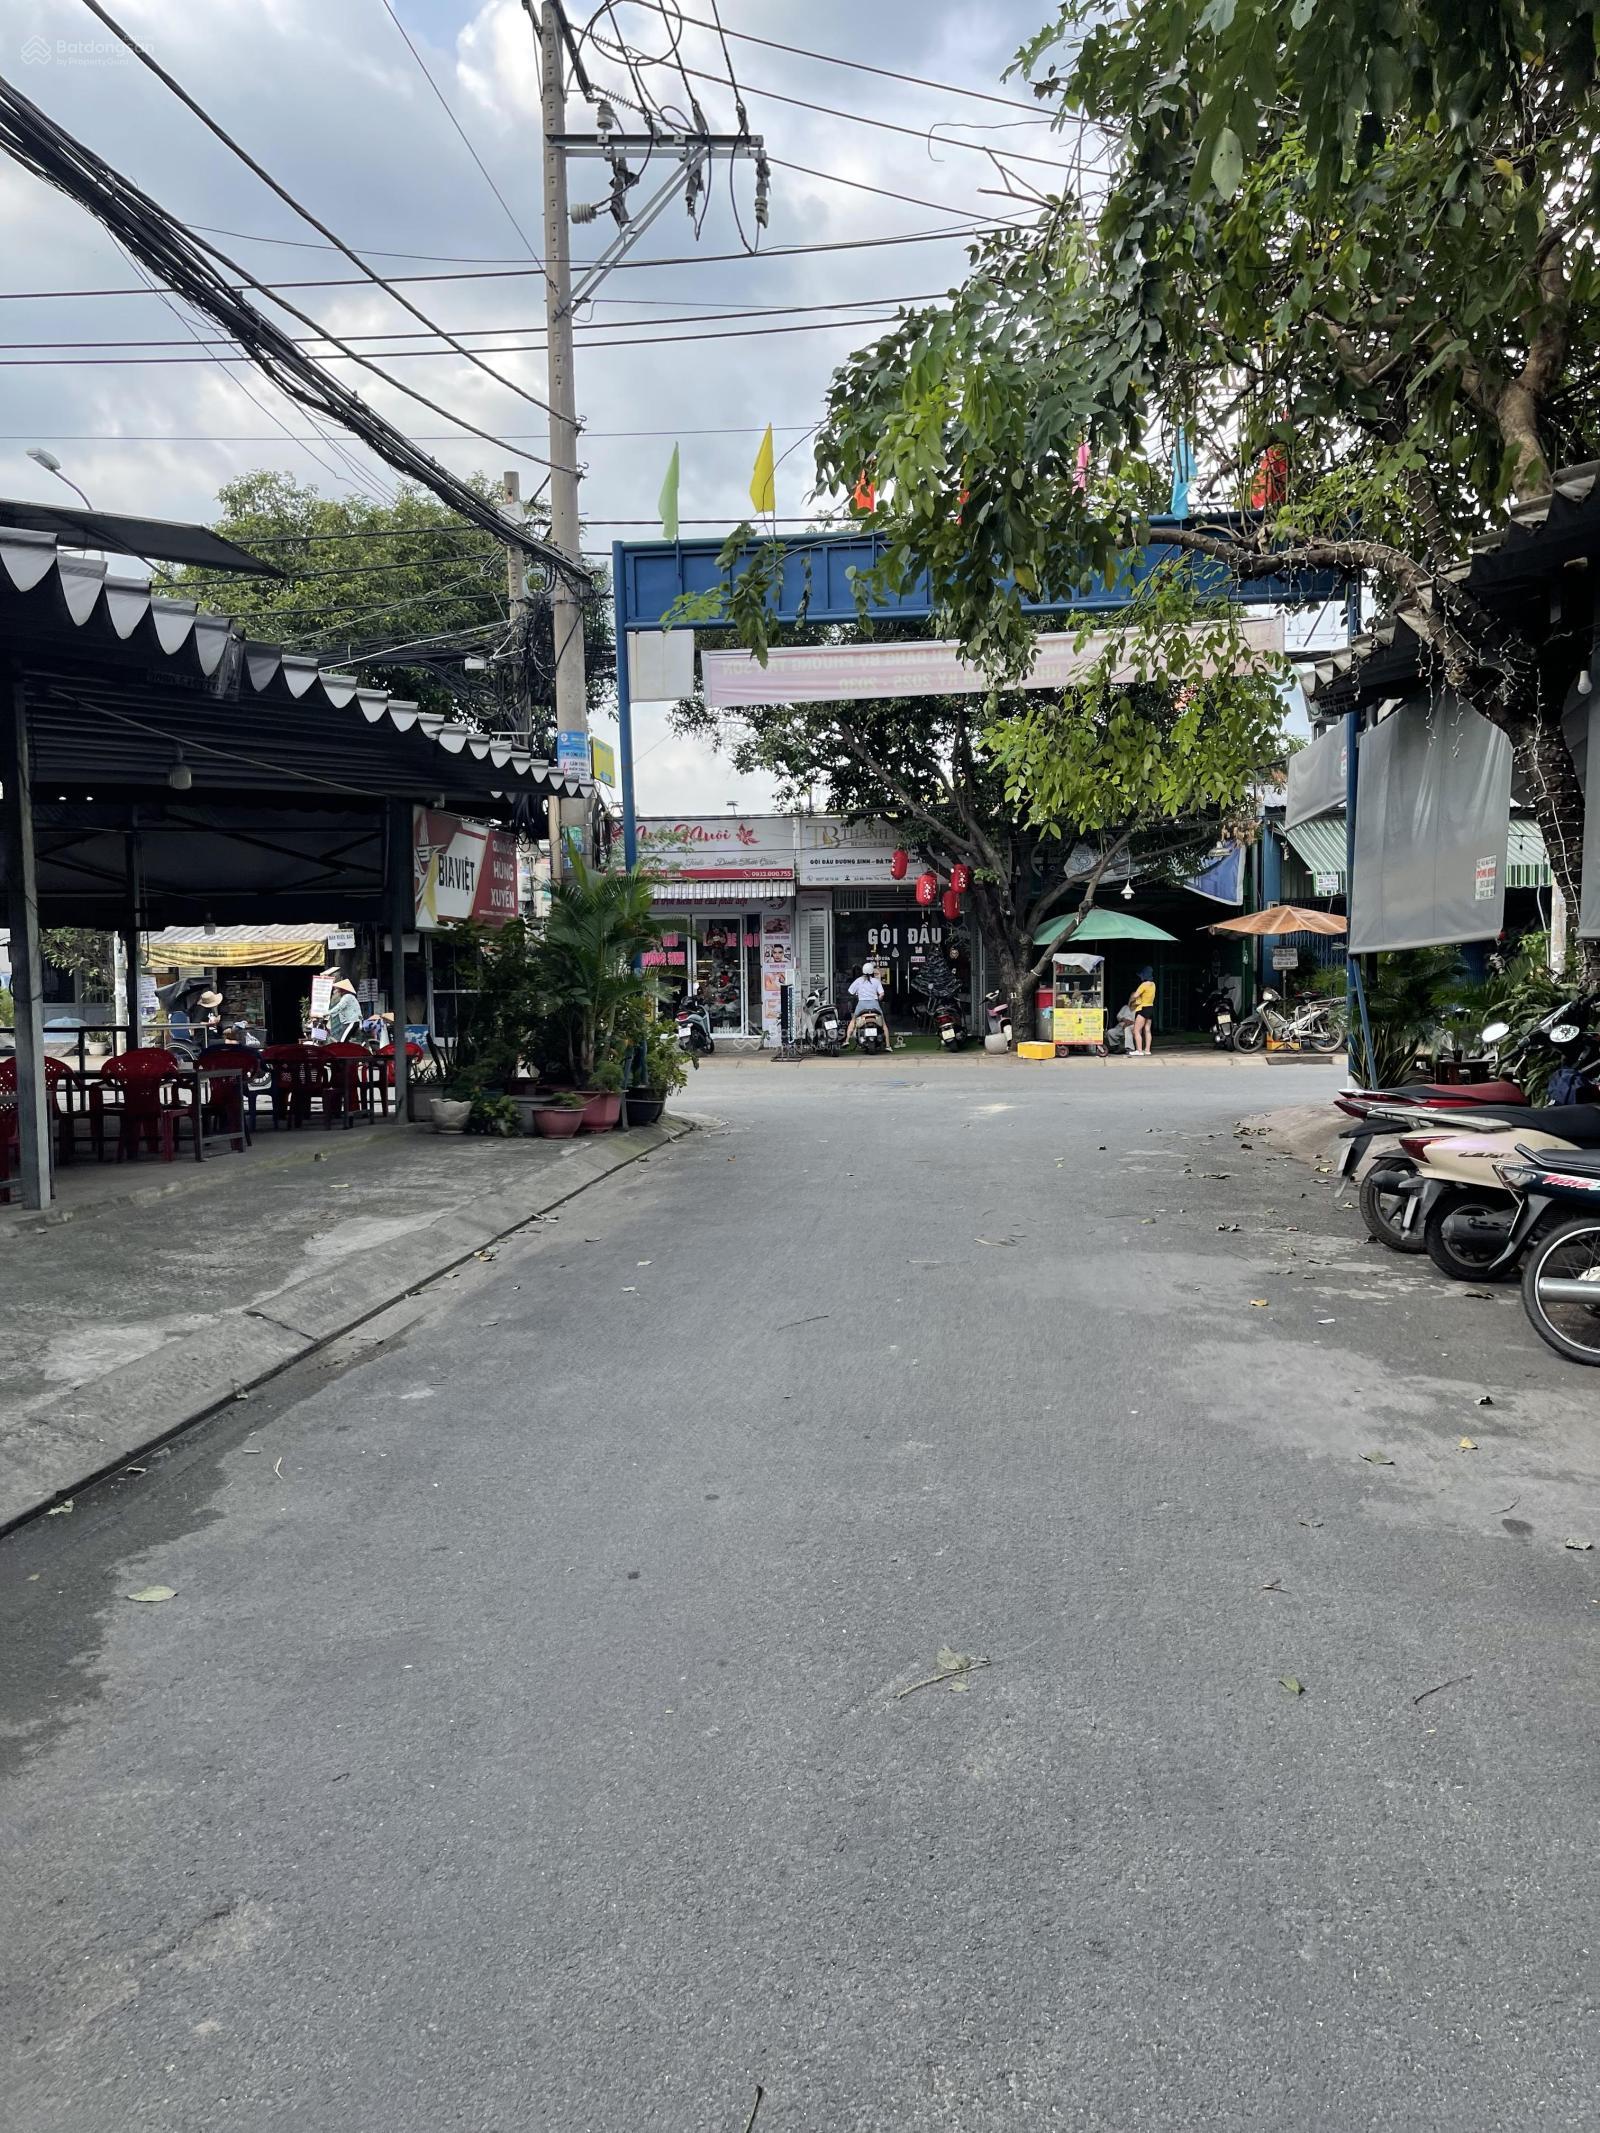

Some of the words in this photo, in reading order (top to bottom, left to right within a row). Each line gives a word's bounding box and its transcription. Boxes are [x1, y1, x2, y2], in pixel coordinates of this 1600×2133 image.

[490, 886, 515, 908] XUYẾN
[868, 923, 898, 949] GỘI
[907, 921, 942, 945] ĐẦU
